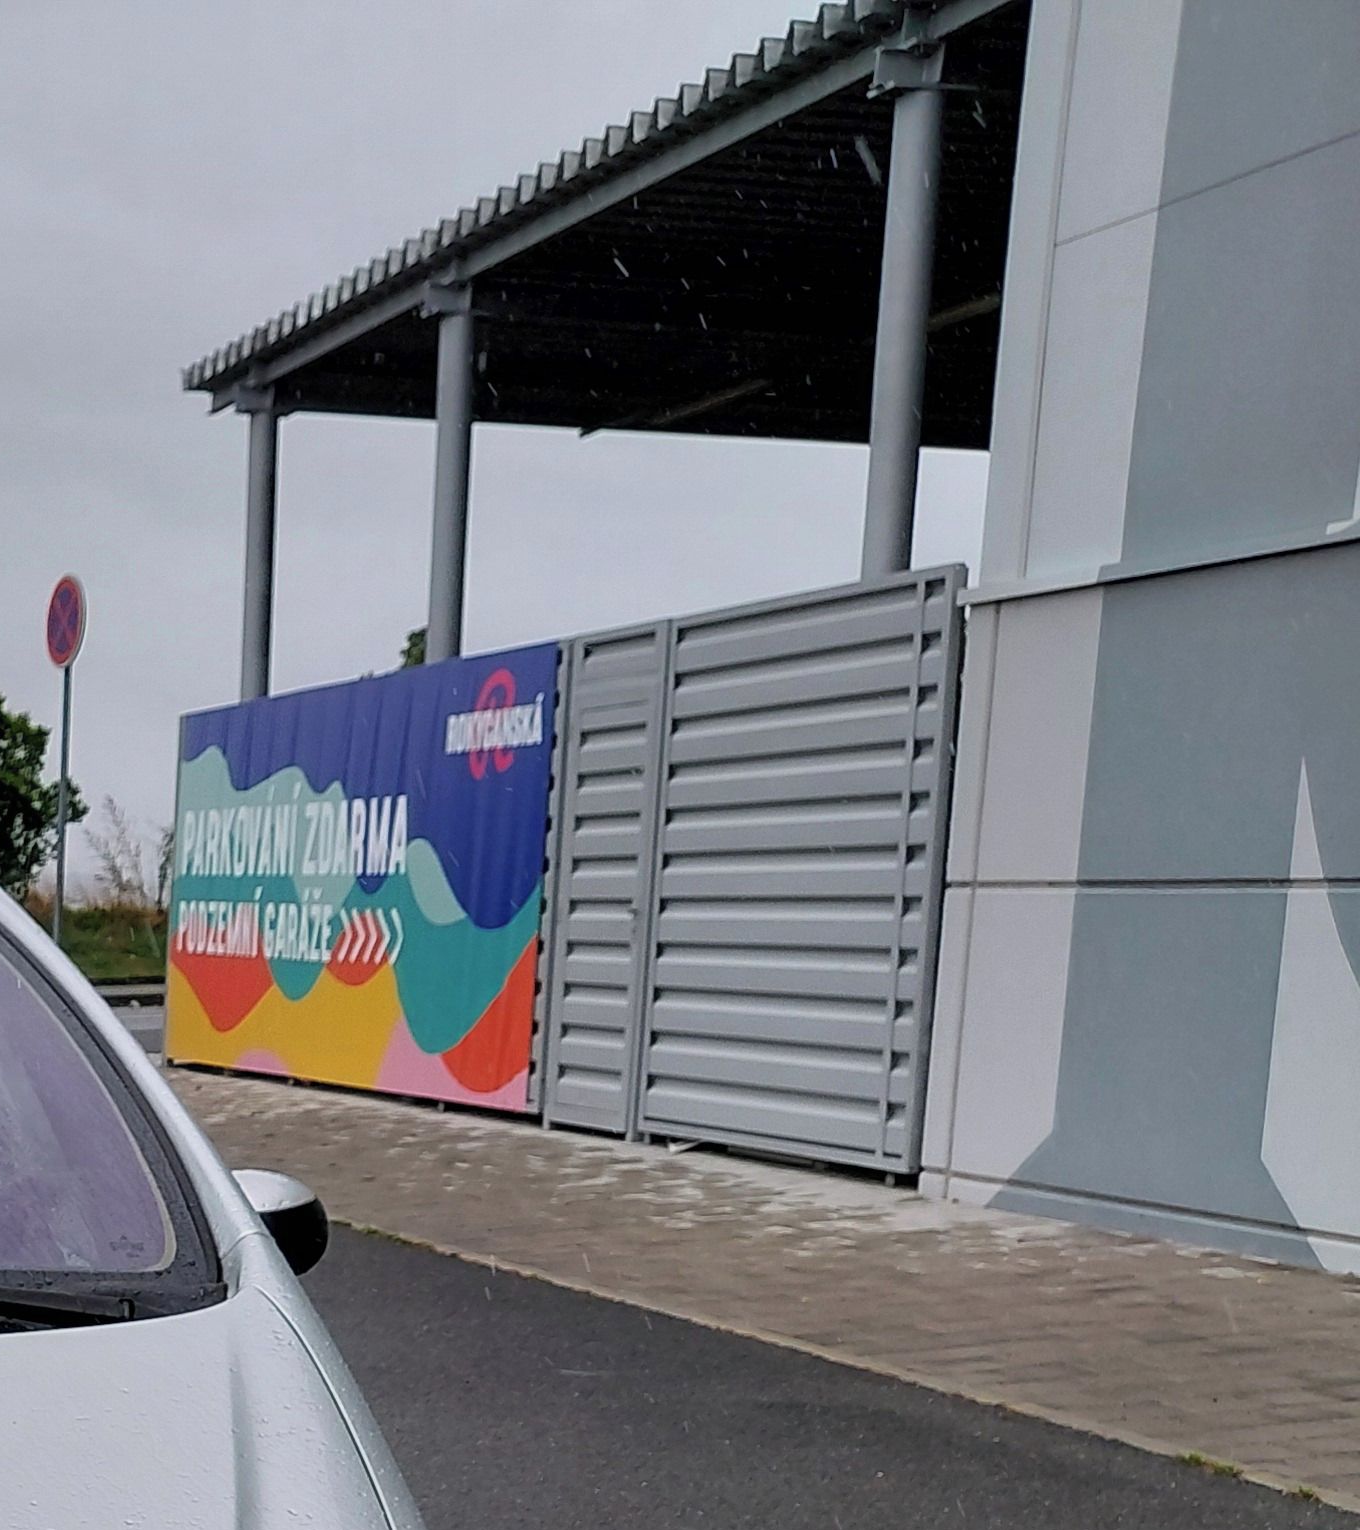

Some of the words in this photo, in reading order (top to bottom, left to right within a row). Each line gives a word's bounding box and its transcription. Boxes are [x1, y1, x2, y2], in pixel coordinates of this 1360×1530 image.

[182, 782, 301, 877] PARKOVÁNÍ
[301, 794, 408, 877] ZDARMA
[176, 886, 264, 959] PODZEMNÍ
[263, 886, 332, 962] GARÁŽE
